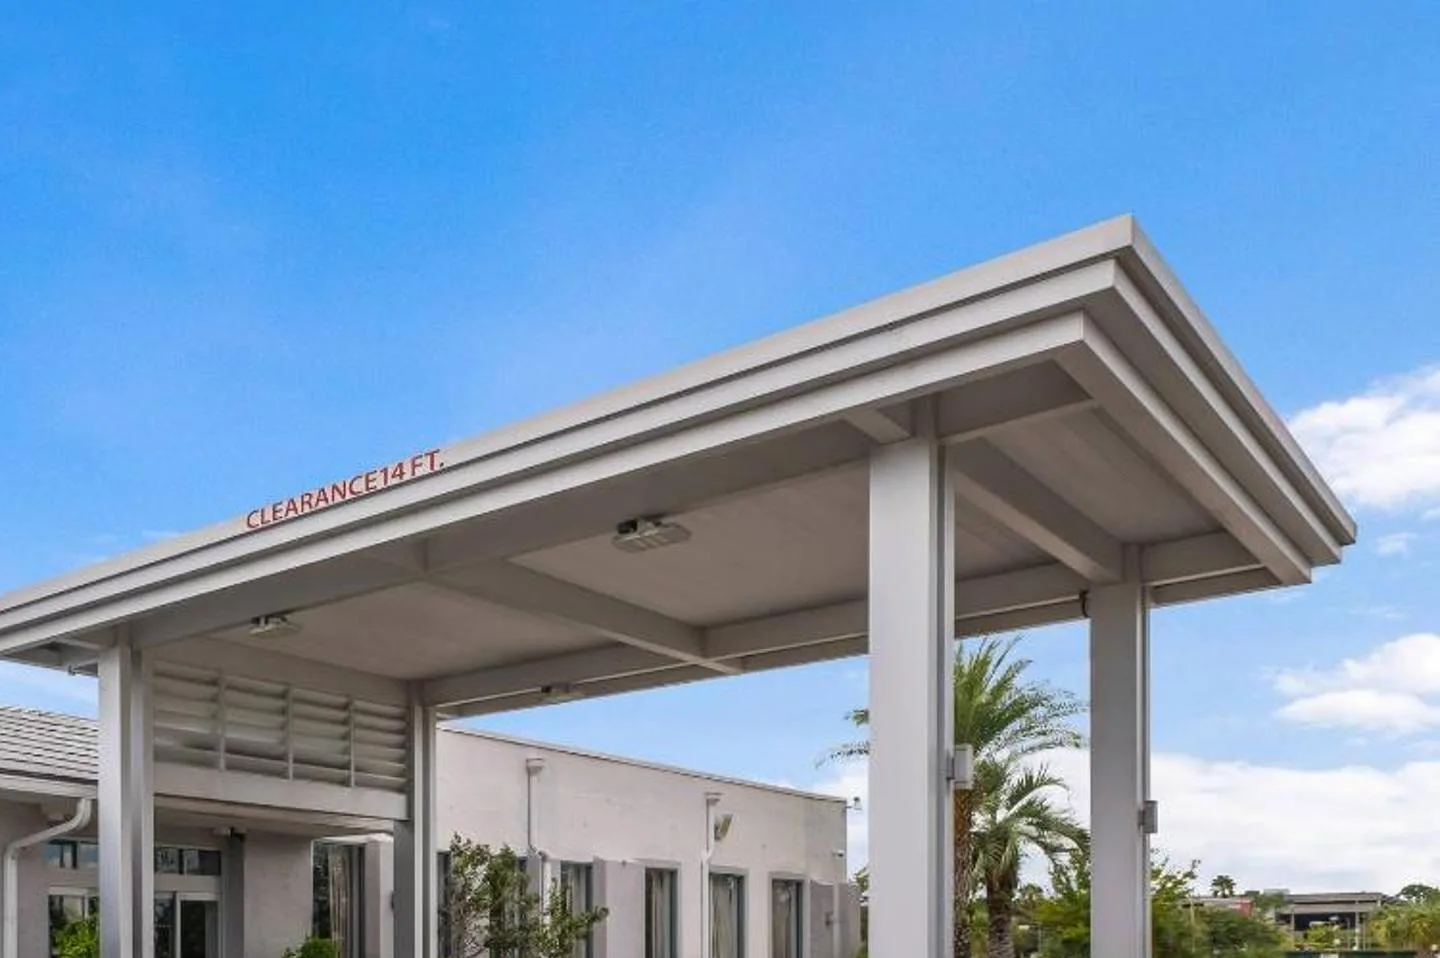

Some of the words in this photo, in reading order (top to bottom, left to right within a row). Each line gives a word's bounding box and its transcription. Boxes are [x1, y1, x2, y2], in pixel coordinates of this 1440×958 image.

[246, 469, 378, 529] CLEARANCE
[380, 462, 405, 486] 14
[410, 449, 444, 477] FT.
